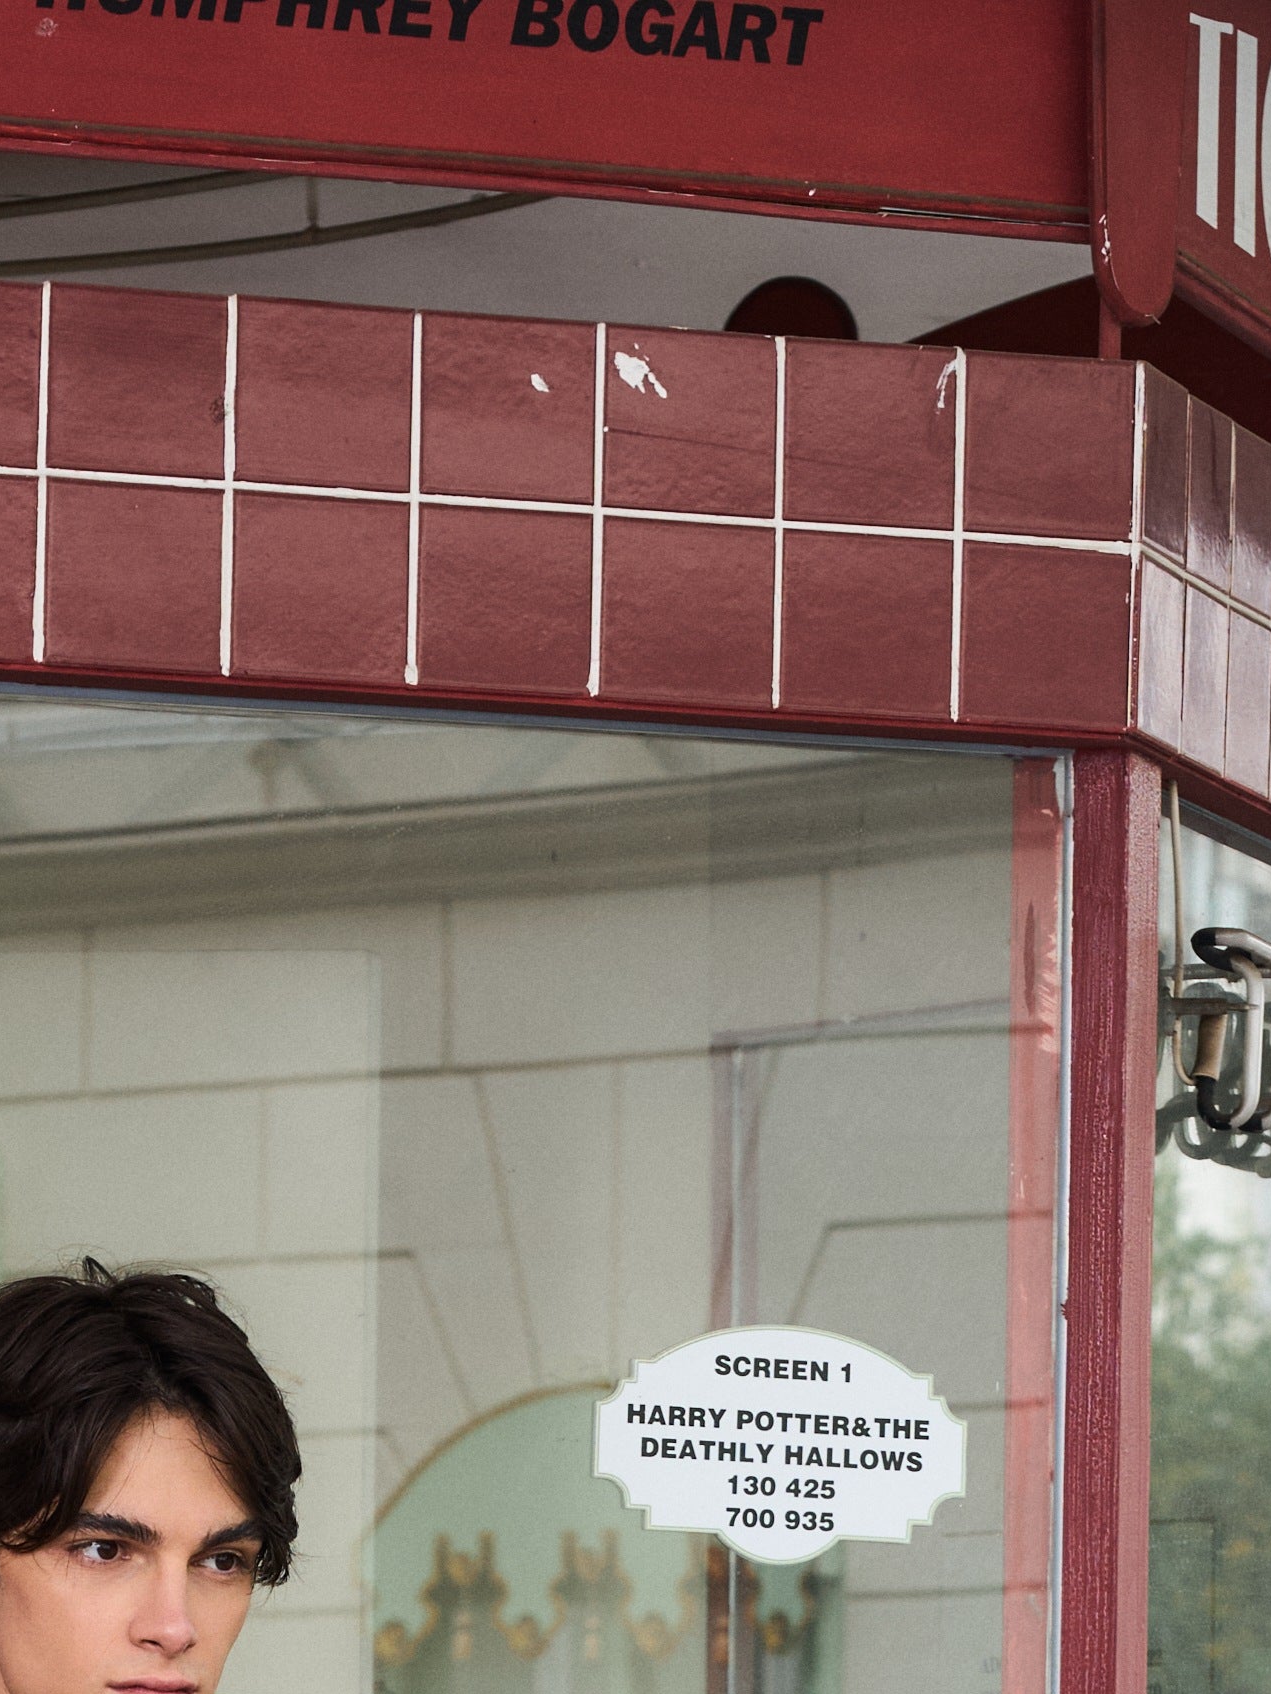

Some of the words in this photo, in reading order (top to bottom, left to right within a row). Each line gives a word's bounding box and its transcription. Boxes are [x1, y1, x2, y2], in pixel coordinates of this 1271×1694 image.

[509, 0, 826, 67] BOGART
[714, 1354, 829, 1382] SCREEN
[841, 1363, 852, 1383] 1
[627, 1403, 727, 1429] HARRY
[641, 1436, 775, 1464] DEATHLY
[784, 1445, 924, 1473] HALLOWS
[727, 1474, 777, 1497] 130
[785, 1478, 837, 1500] 425
[725, 1507, 776, 1529] 700
[784, 1510, 835, 1532] 935
